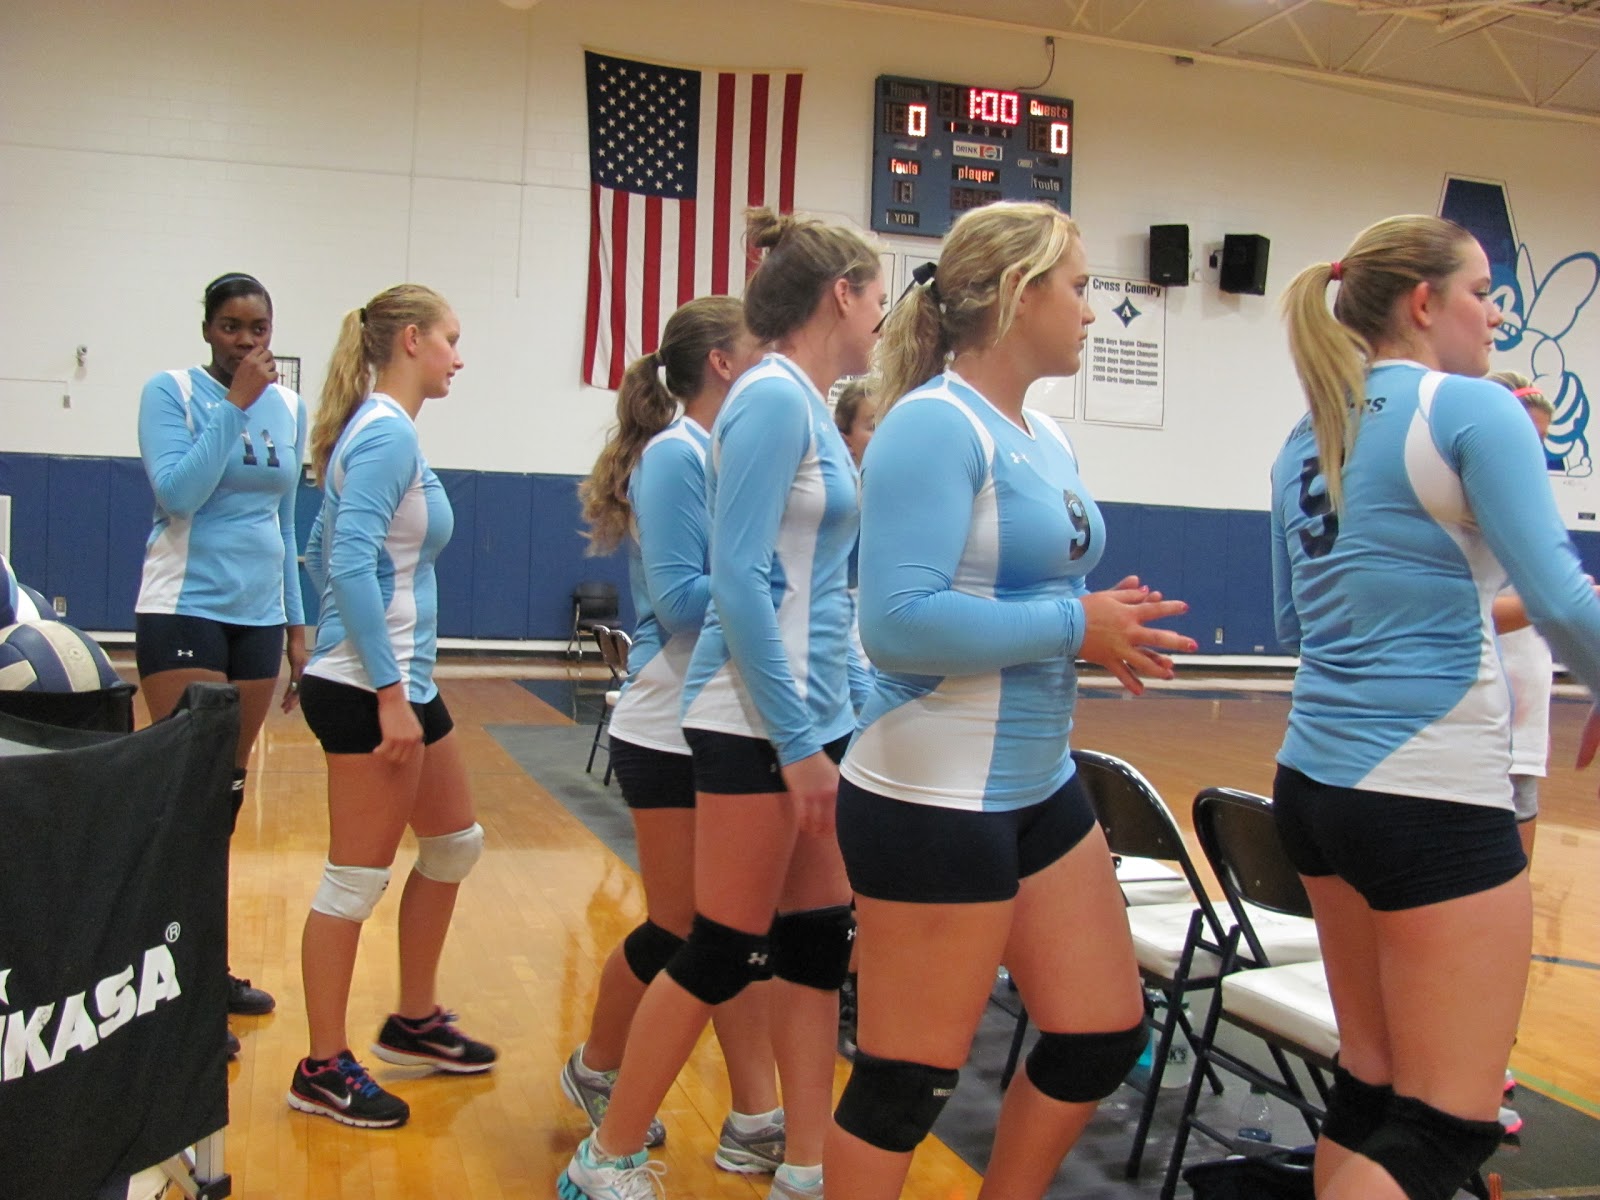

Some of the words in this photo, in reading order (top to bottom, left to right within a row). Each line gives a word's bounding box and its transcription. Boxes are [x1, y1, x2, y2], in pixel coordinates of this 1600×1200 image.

[908, 104, 927, 137] 0
[969, 88, 1018, 125] 1:00
[1029, 99, 1068, 119] Guests
[955, 145, 979, 156] DRINK
[1050, 122, 1069, 155] 0
[891, 158, 918, 176] fouls
[958, 165, 994, 184] player
[1093, 278, 1120, 292] Cross
[1125, 281, 1161, 298] Country
[241, 428, 280, 468] 11
[1062, 490, 1091, 561] 9
[0, 944, 182, 1082] KASA
